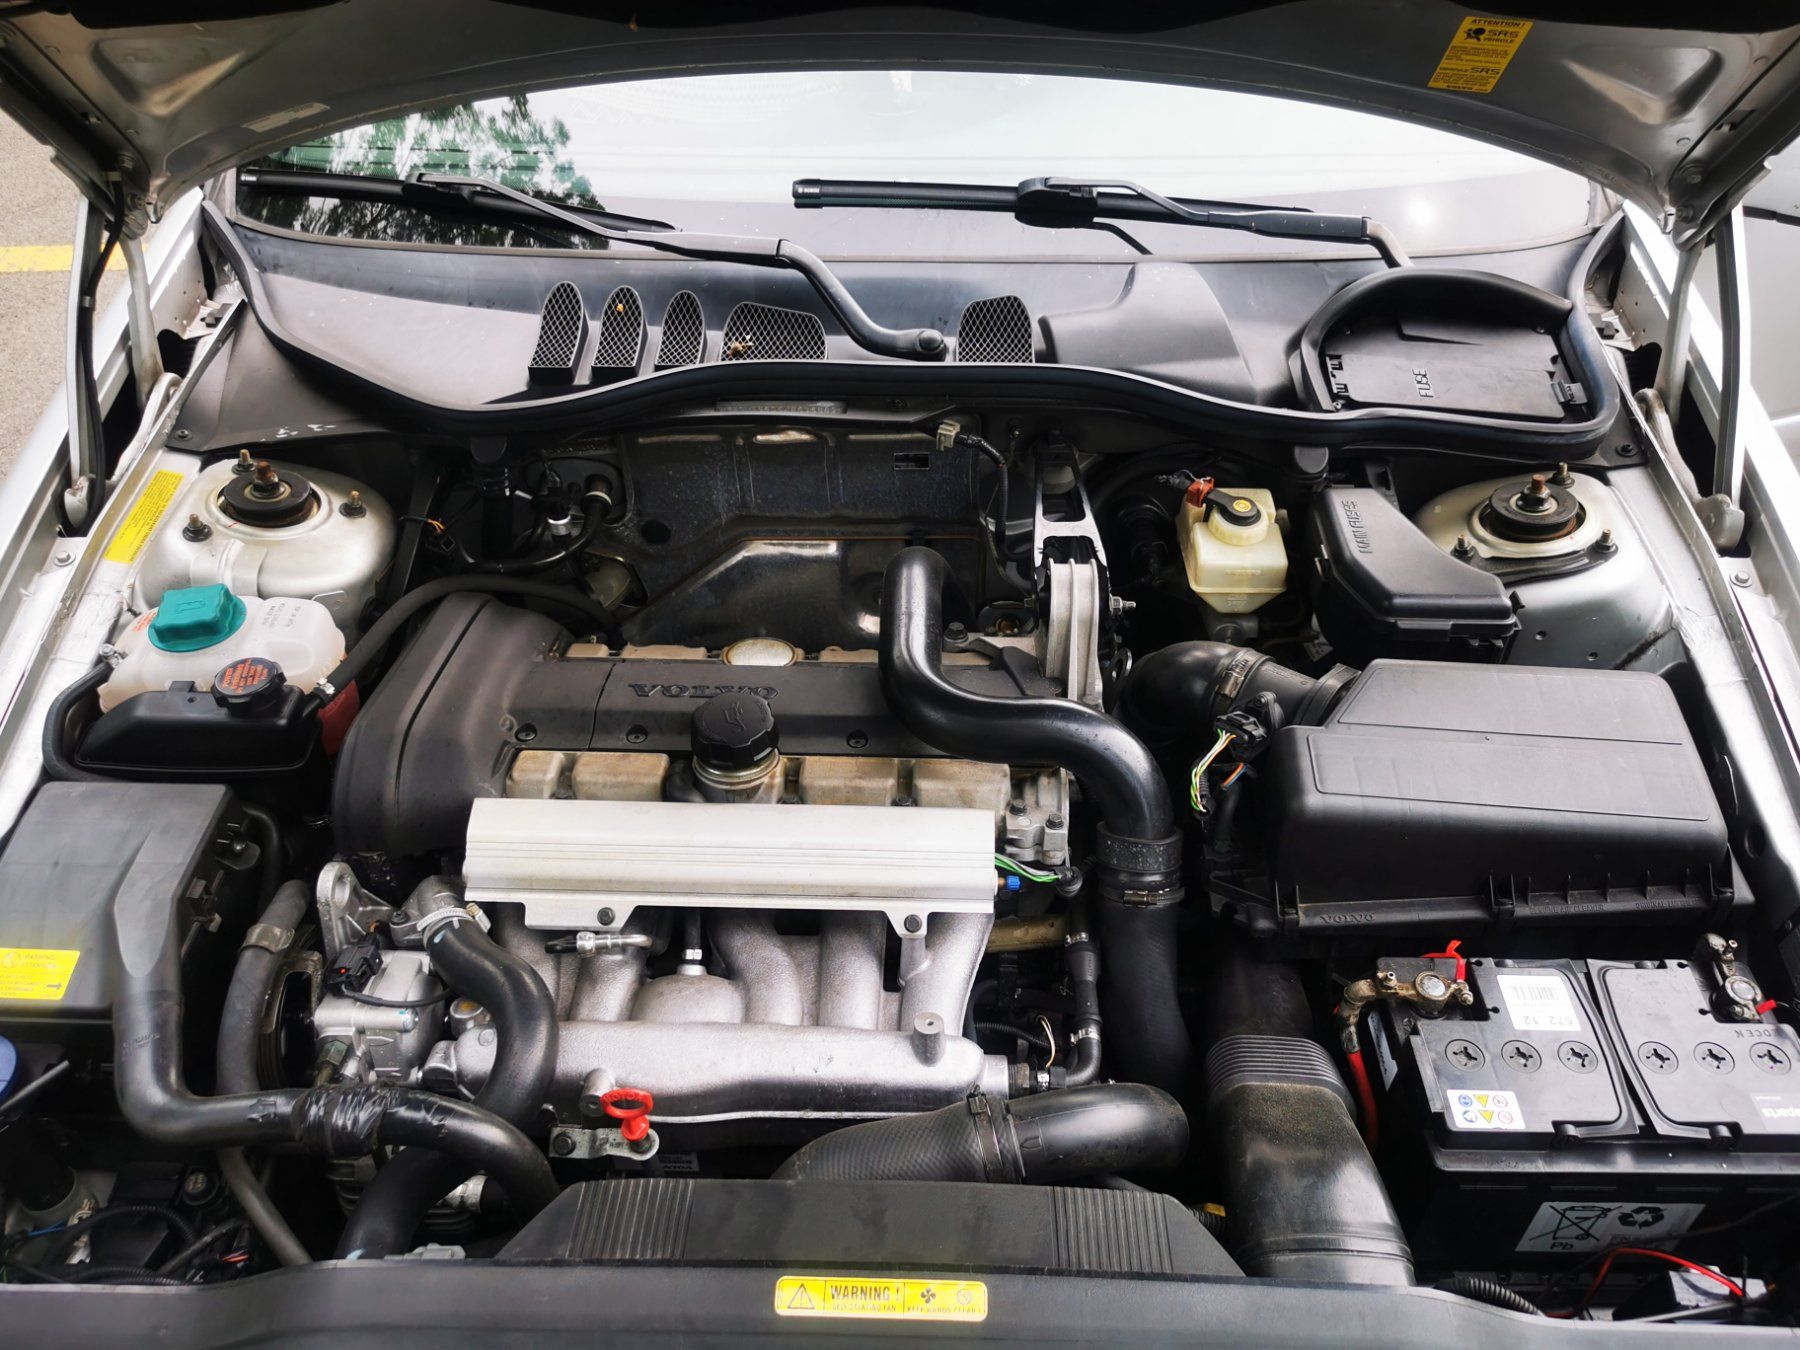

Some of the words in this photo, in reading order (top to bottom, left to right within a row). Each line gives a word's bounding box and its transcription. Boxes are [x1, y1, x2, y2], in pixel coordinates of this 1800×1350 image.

[1487, 30, 1519, 38] SRS
[1470, 67, 1501, 75] SRS
[1412, 368, 1434, 398] FUSE
[1352, 530, 1373, 554] MAIN
[628, 683, 779, 699] VOLVO
[1319, 913, 1375, 925] VOLVO
[1547, 1015, 1573, 1026] 572
[1550, 1242, 1574, 1250] Pb
[830, 1284, 890, 1302] WARNING
